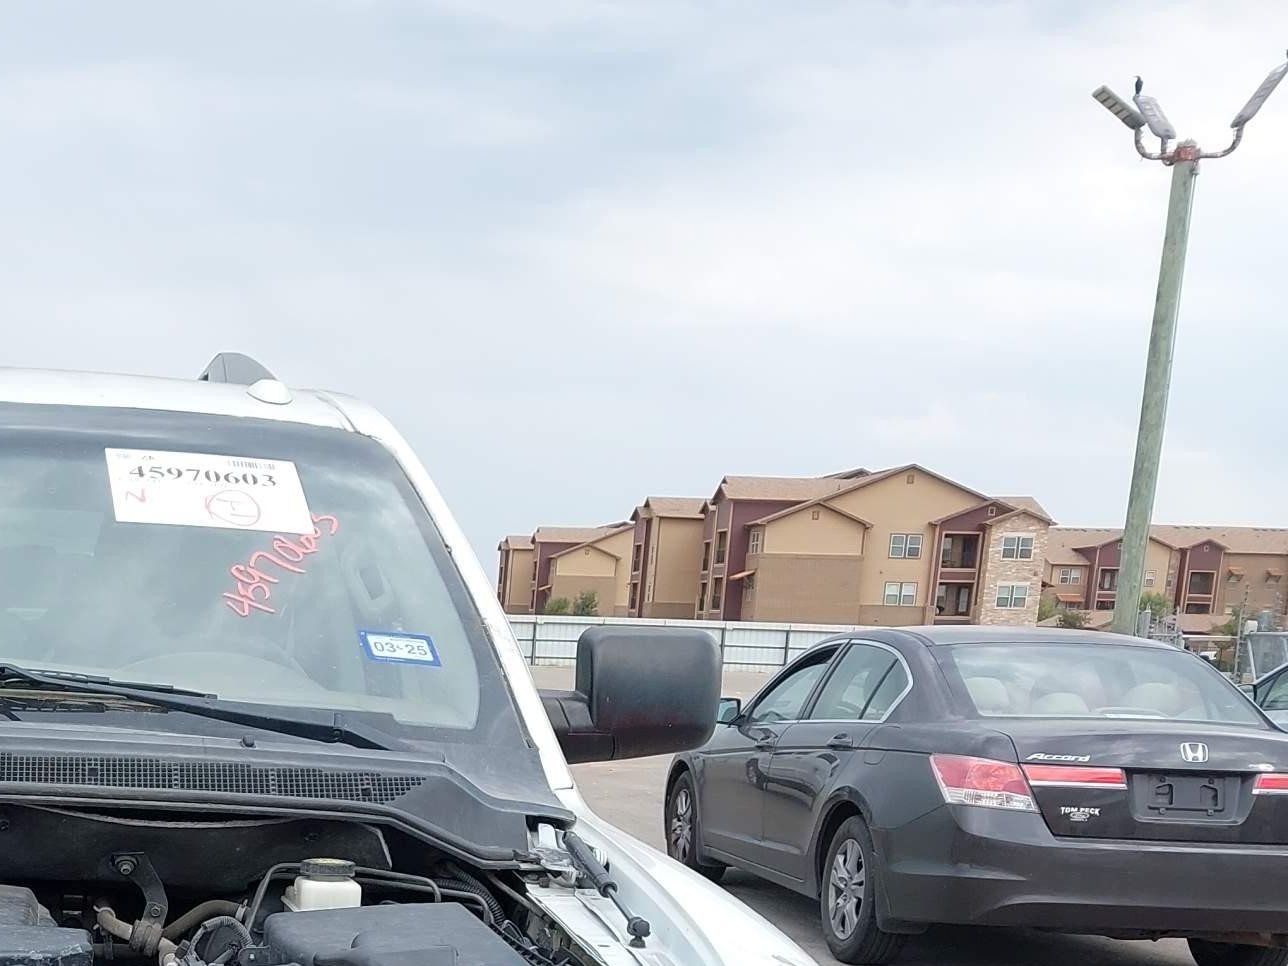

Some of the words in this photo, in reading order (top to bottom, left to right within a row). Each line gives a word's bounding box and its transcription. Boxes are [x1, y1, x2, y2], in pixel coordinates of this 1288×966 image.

[129, 465, 277, 487] 45970603
[1025, 752, 1091, 762] Accord
[1060, 806, 1079, 815] TOM
